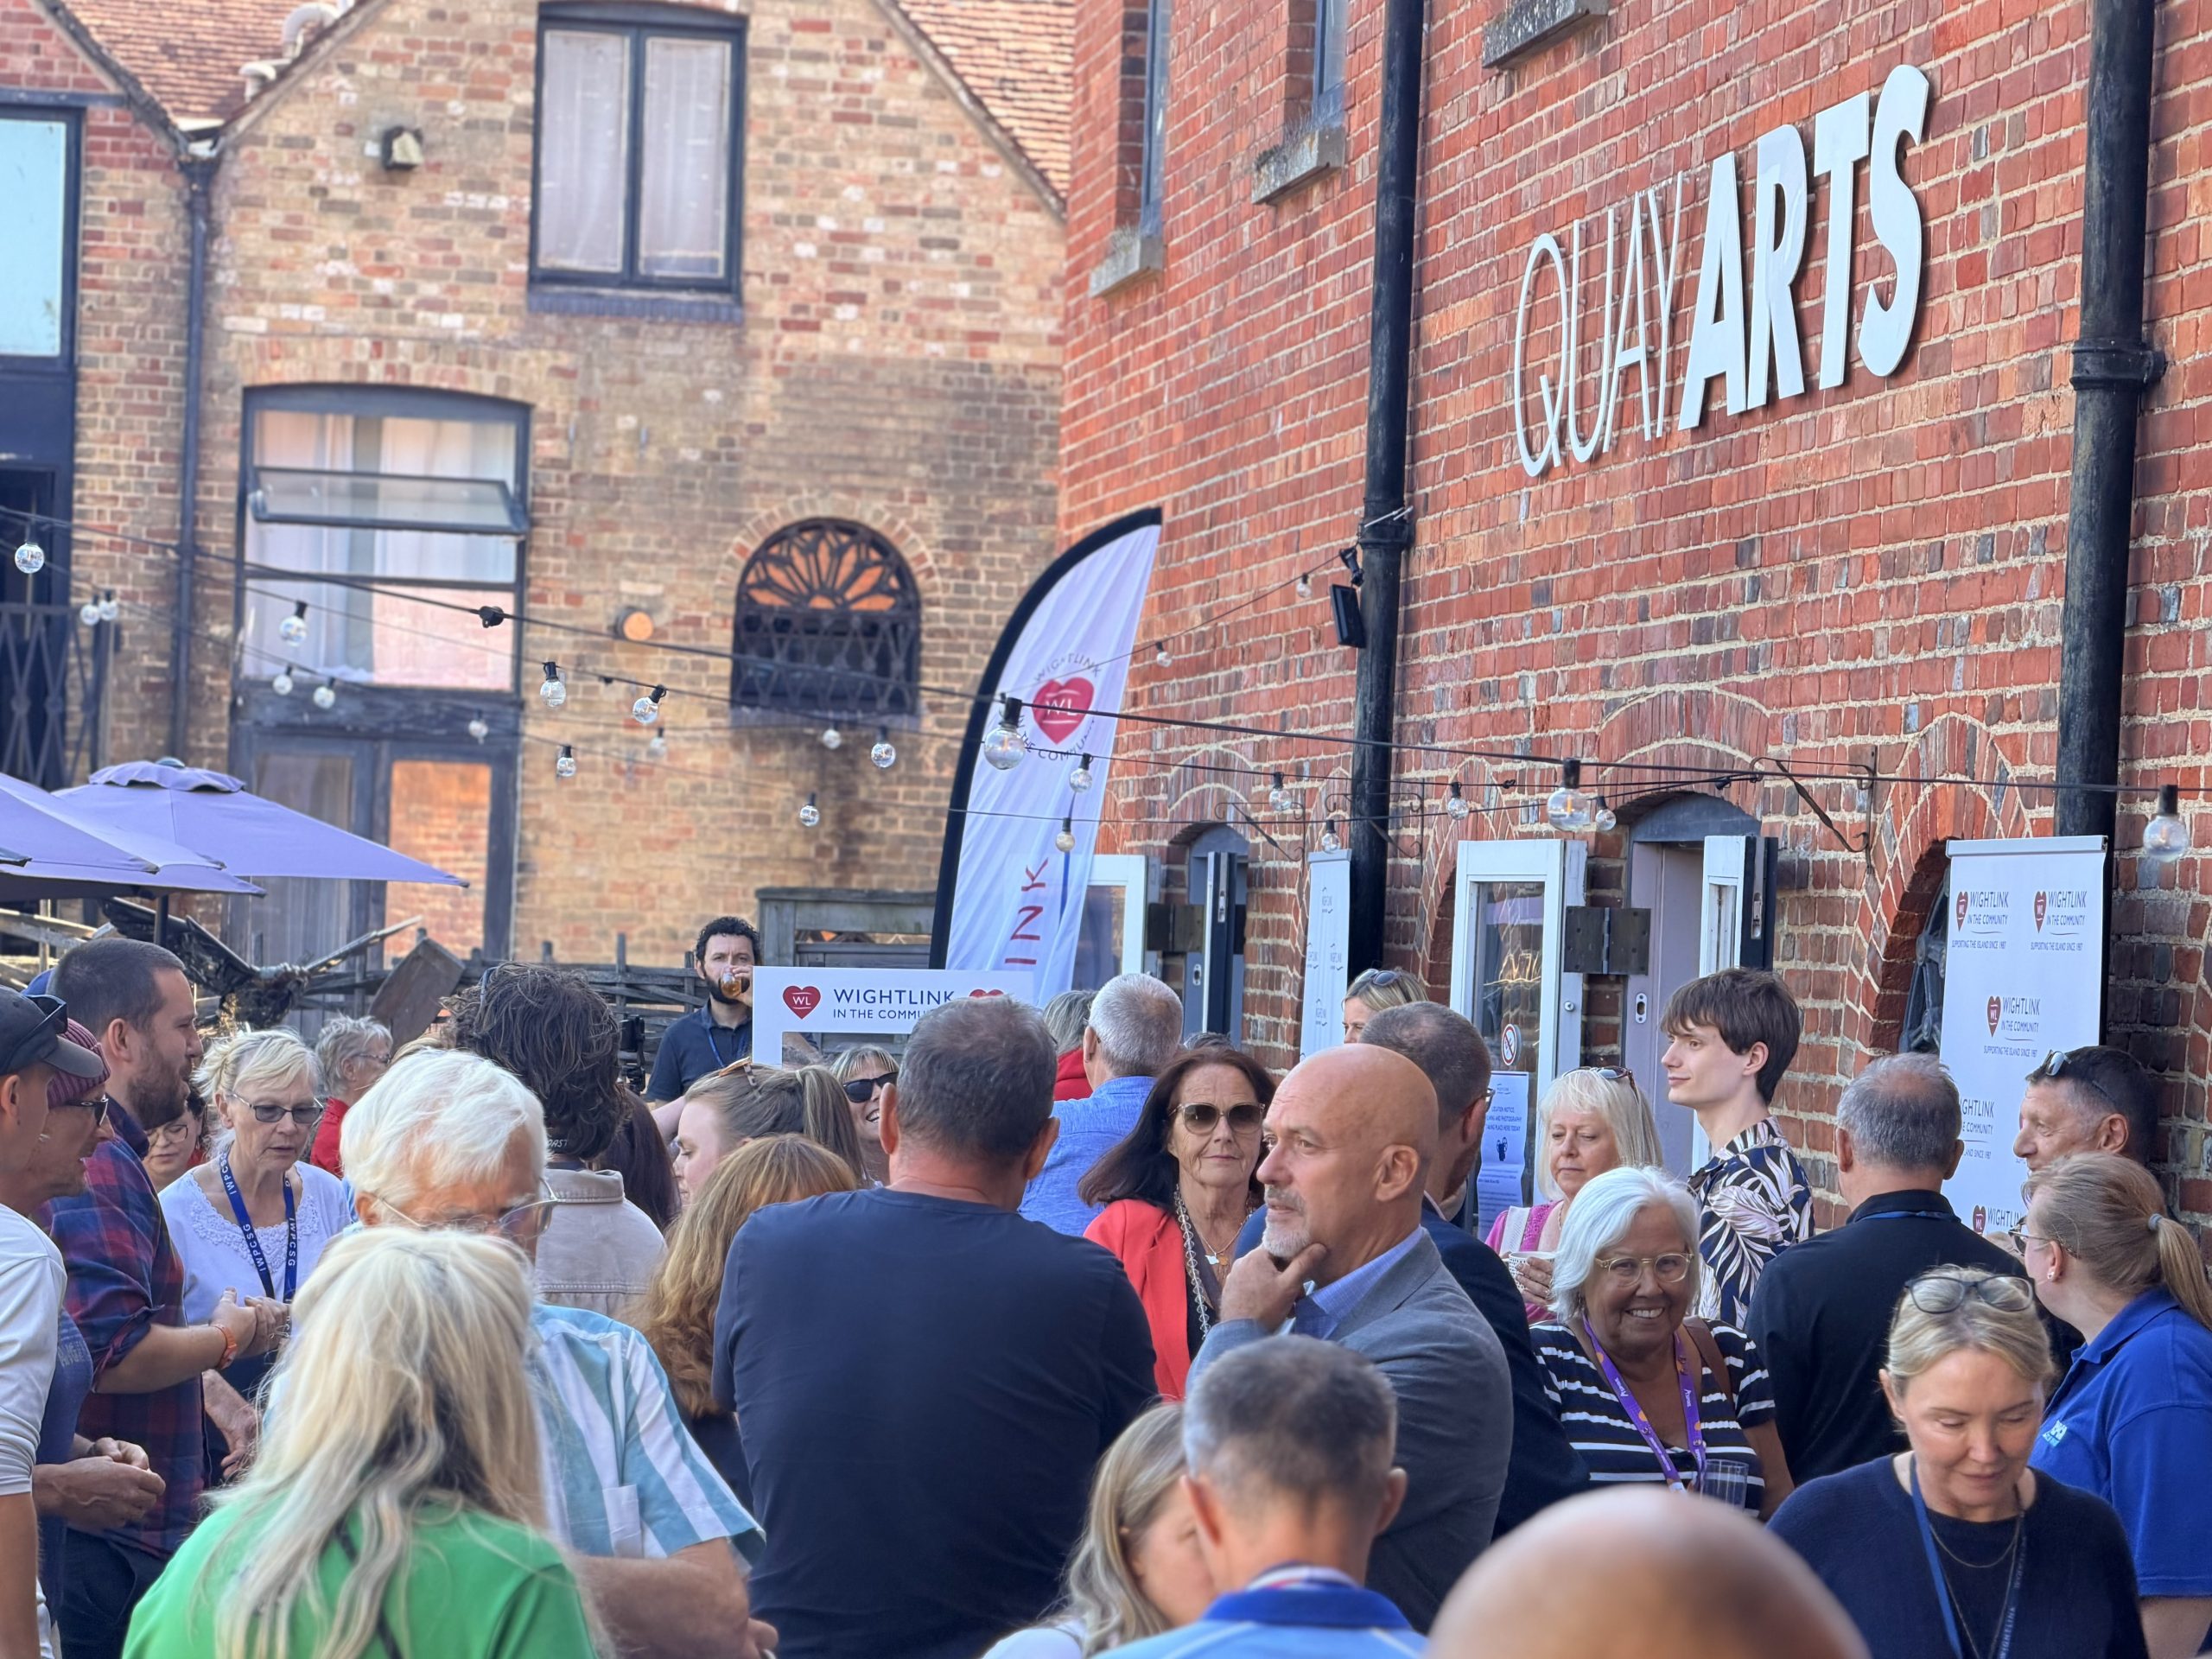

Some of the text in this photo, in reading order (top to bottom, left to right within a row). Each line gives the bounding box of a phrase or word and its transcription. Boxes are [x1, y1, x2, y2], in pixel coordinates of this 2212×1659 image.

[1046, 698, 1077, 715] WL
[1970, 891, 2009, 908] WIGHTLINK
[2049, 890, 2088, 908] WIGHTLINK
[1004, 857, 1048, 965] INK
[1982, 914, 2008, 925] COMMUNITY
[2060, 915, 2086, 926] COMMUNITY
[792, 996, 811, 1006] WL
[834, 988, 955, 1005] WIGHTLINK
[833, 1009, 847, 1019] IN
[850, 1009, 874, 1019] THE
[2002, 997, 2040, 1015] WIGHTLINK
[2013, 1020, 2039, 1033] COMMUNITY
[1966, 1122, 1993, 1135] COMMUNITY
[219, 1153, 237, 1195] IWPCS
[243, 1224, 266, 1272] IWPCSG
[288, 1217, 296, 1267] IWPCSG
